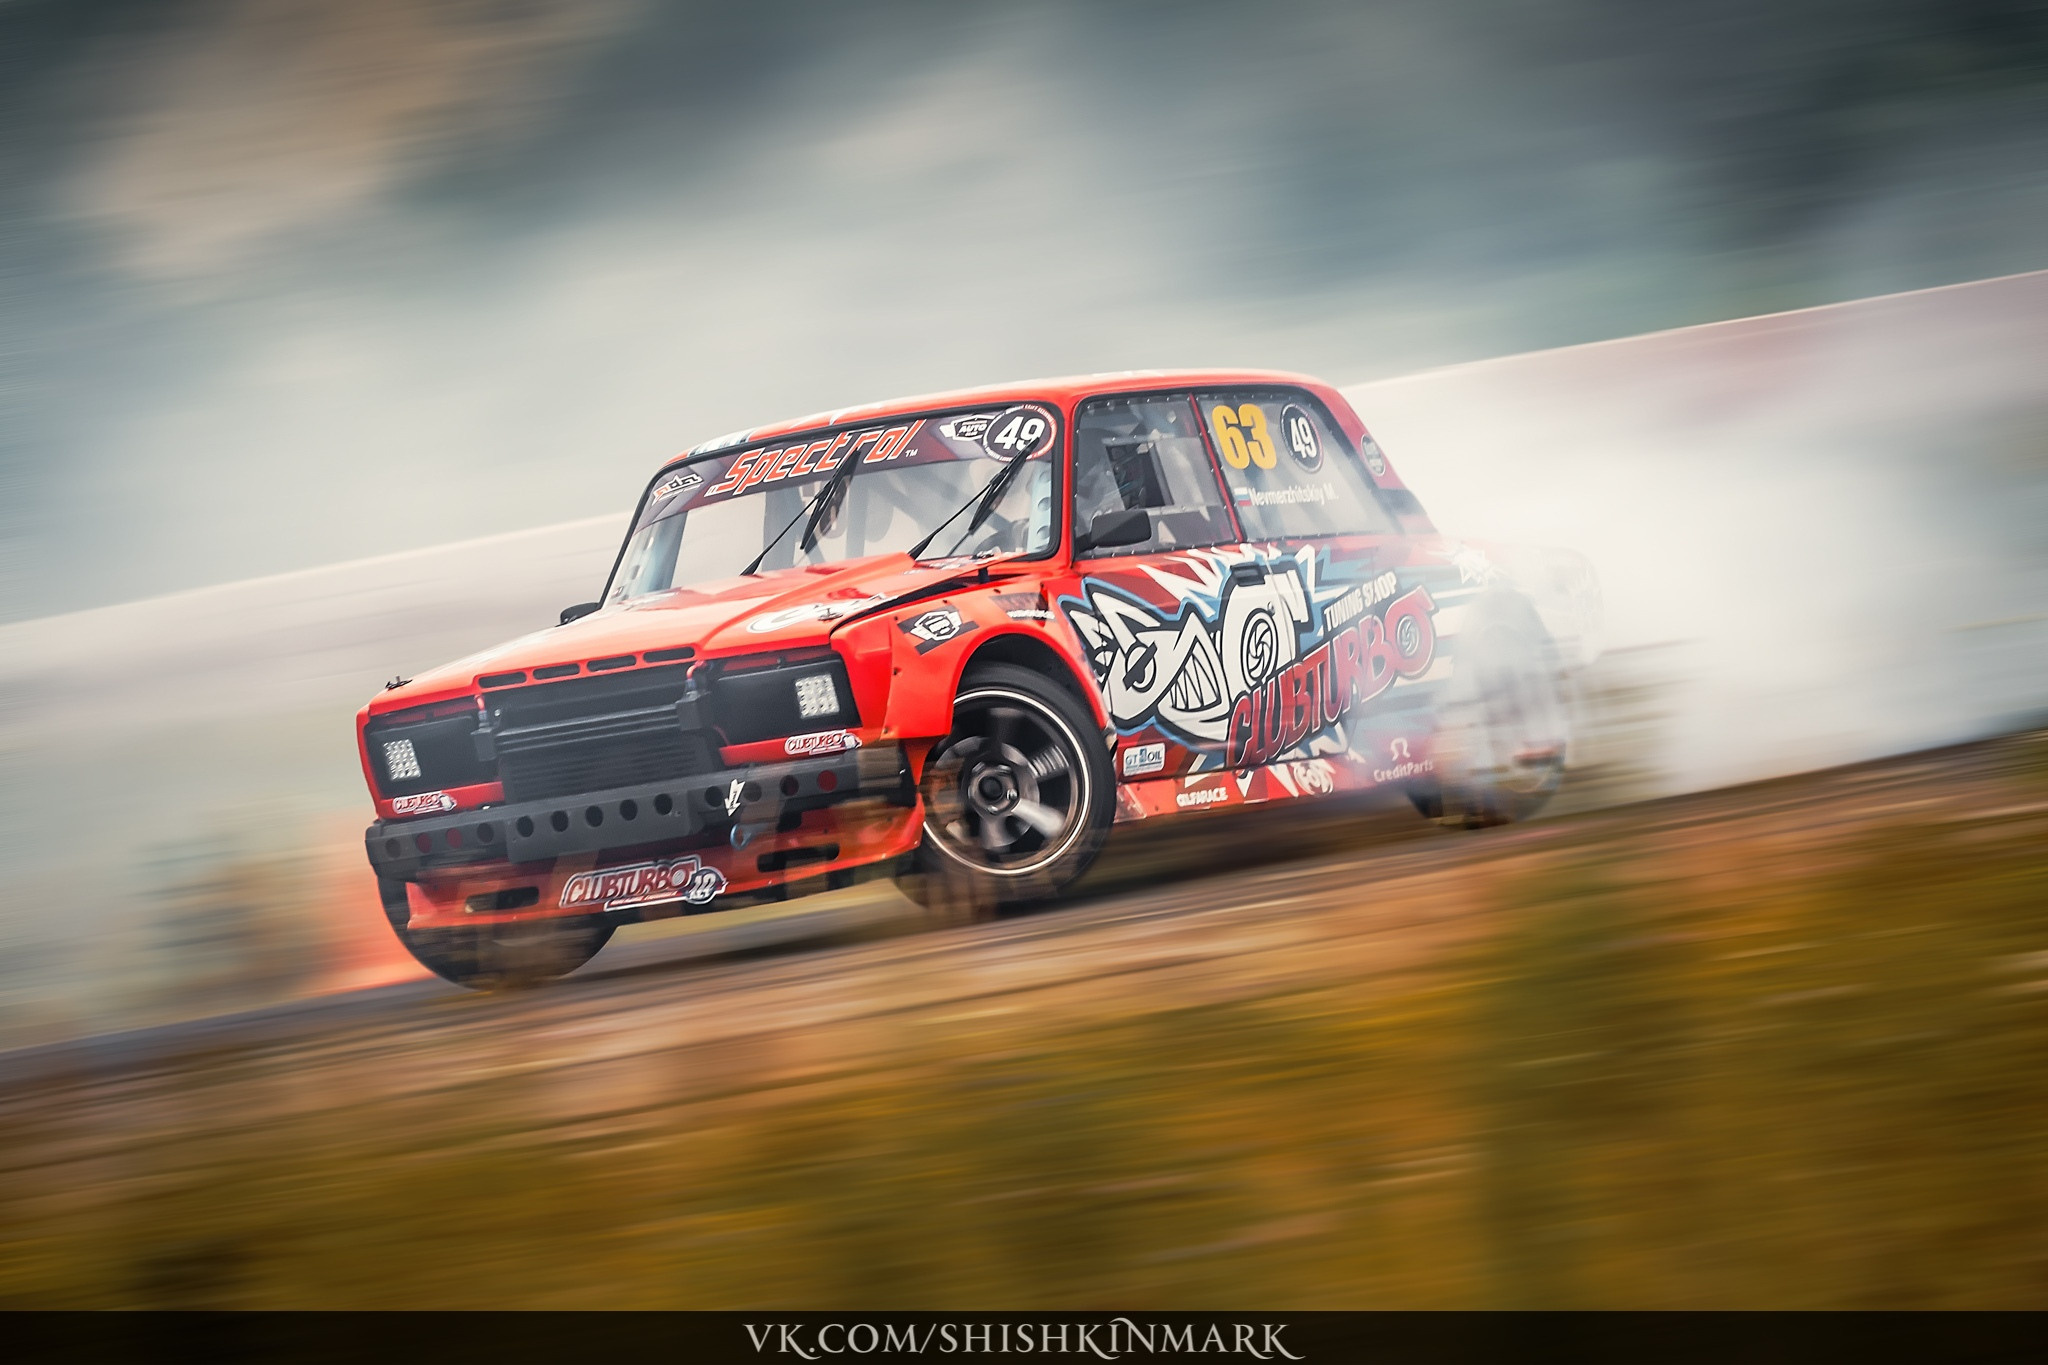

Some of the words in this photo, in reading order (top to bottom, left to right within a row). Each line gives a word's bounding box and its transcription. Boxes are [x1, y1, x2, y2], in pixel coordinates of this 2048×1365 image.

[704, 419, 927, 497] Spectrol
[994, 416, 1046, 450] 49
[1212, 404, 1277, 469] 63
[1290, 417, 1317, 458] 49
[1324, 588, 1364, 632] TUNING
[1362, 571, 1397, 608] SHOP
[1226, 585, 1436, 770] CLUBTURBO
[1373, 760, 1434, 782] CreditParts
[562, 858, 697, 905] CLUBTURBO
